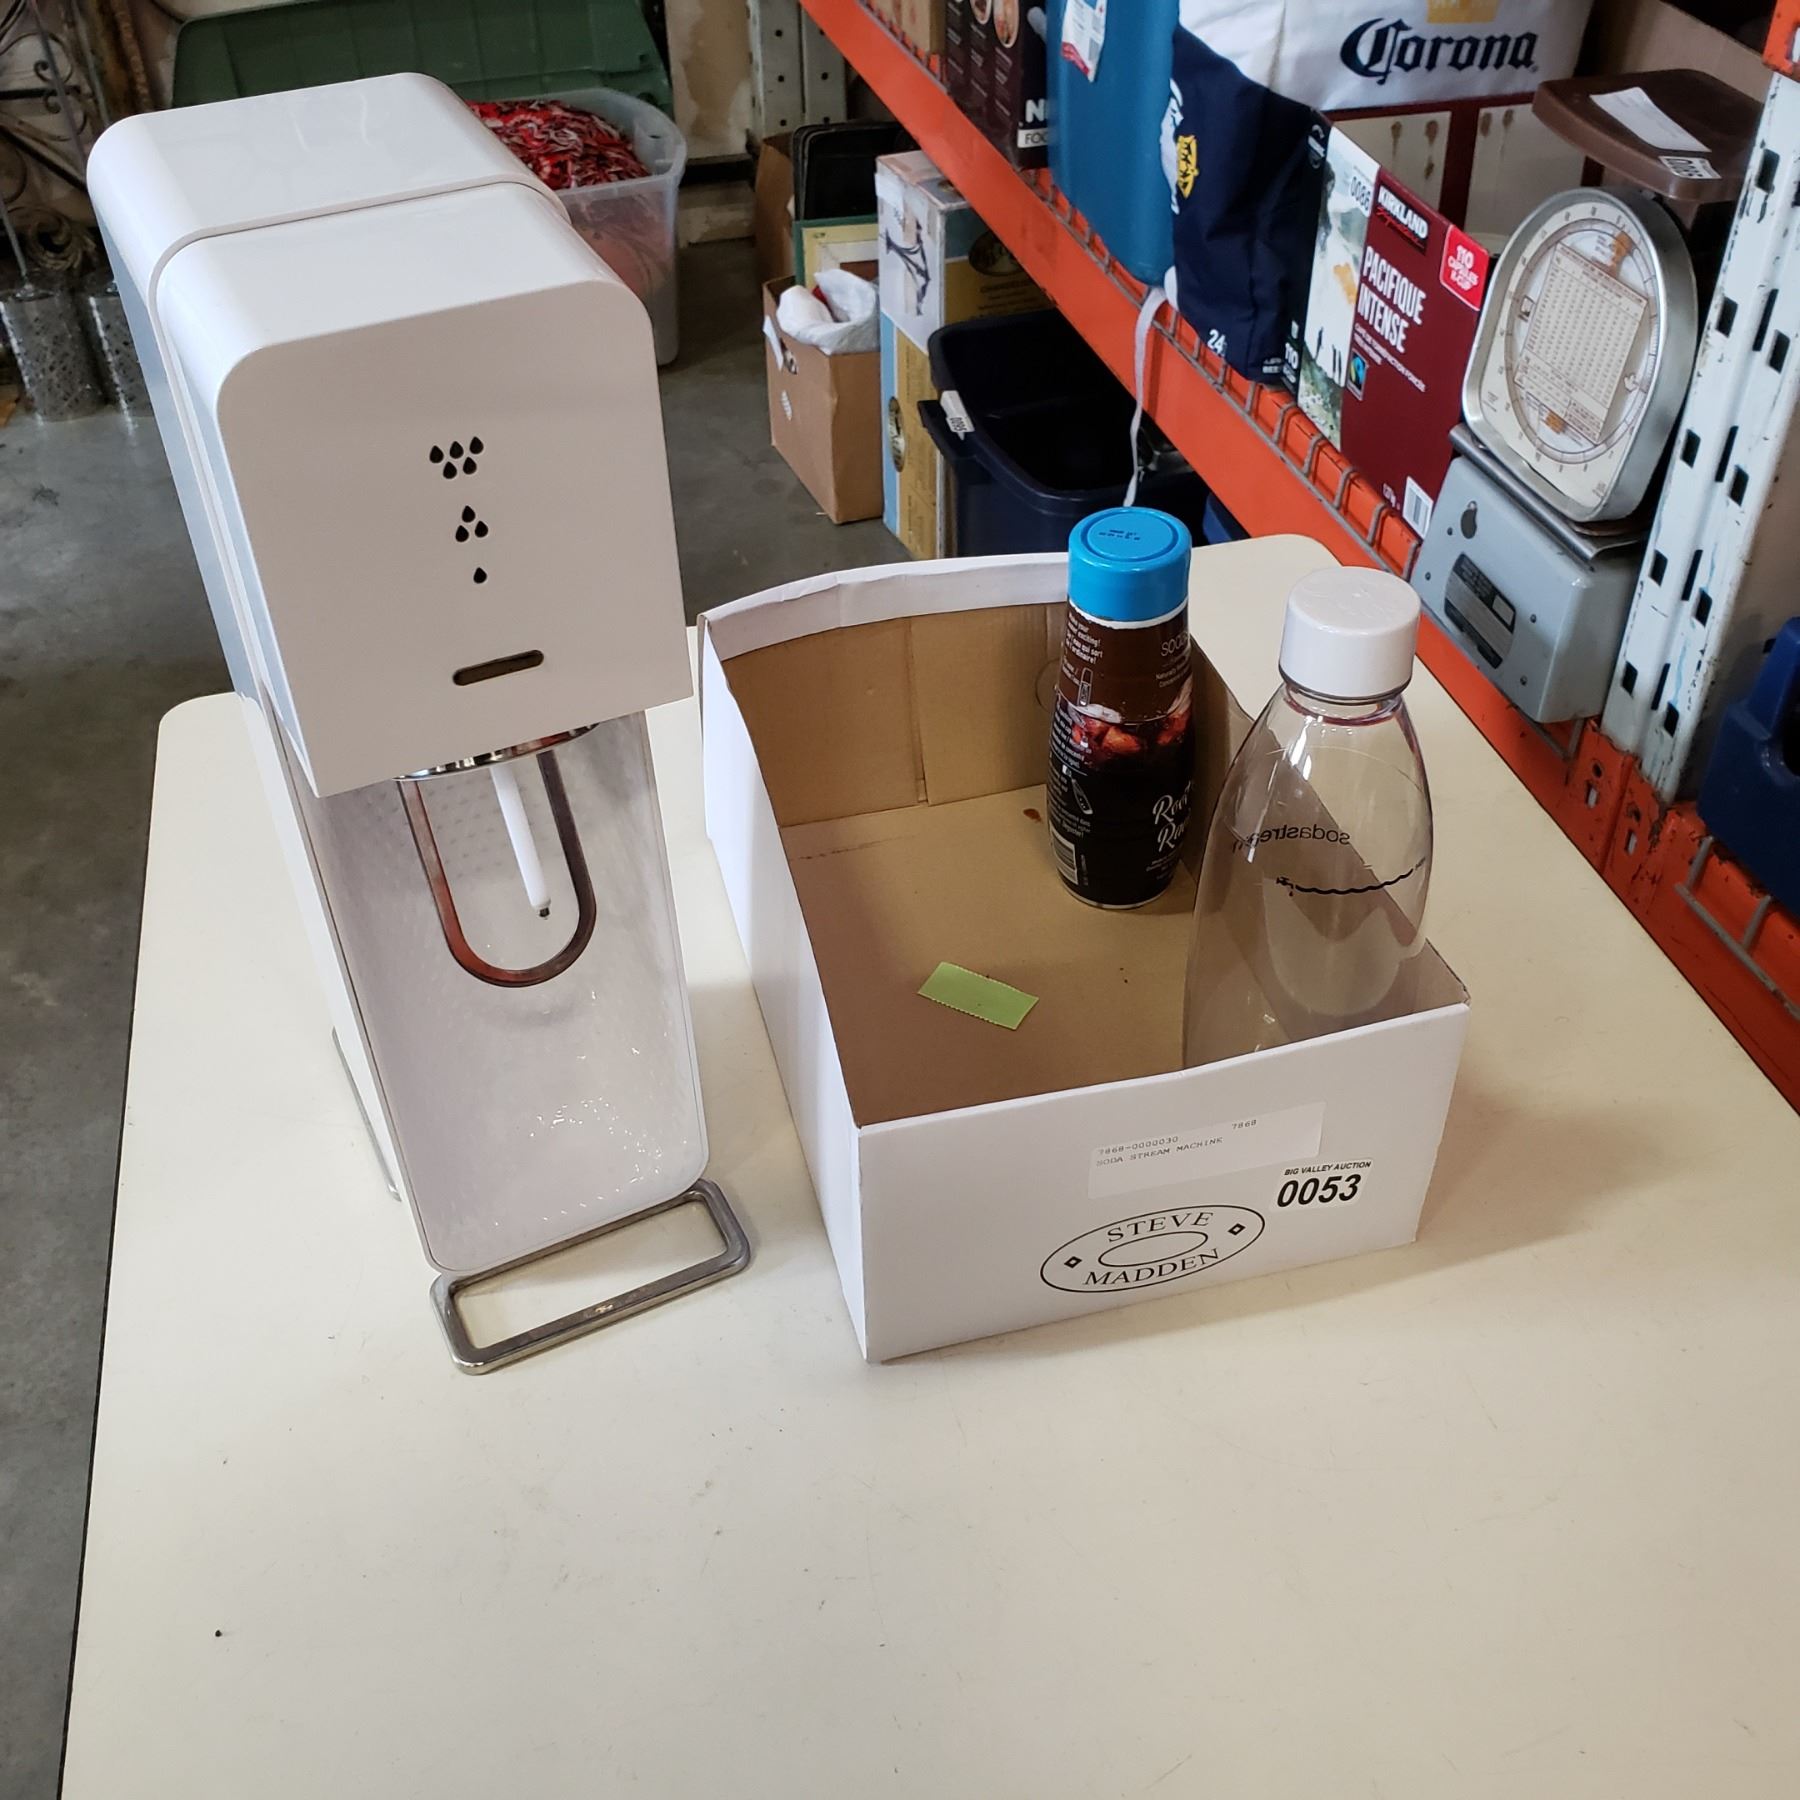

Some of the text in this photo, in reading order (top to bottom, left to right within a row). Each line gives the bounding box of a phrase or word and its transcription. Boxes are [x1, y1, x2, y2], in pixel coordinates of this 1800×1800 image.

[1340, 18, 1539, 85] Corona
[1378, 186, 1428, 239] KIRKLAND
[1457, 245, 1474, 269] 110
[1363, 246, 1427, 325] PACIFIQUE
[1358, 283, 1409, 353] INTENSE
[1207, 329, 1225, 355] 24
[1096, 1137, 1223, 1167] SODA STREAM MACHINE
[1098, 1119, 1257, 1155] 7868-0000030 7868
[1301, 1164, 1333, 1174] VALLEY
[1333, 1161, 1371, 1170] AUCTION
[1277, 1174, 1361, 1207] 0053
[1106, 1212, 1214, 1243] STEVE
[1082, 1248, 1220, 1285] MADDEN
